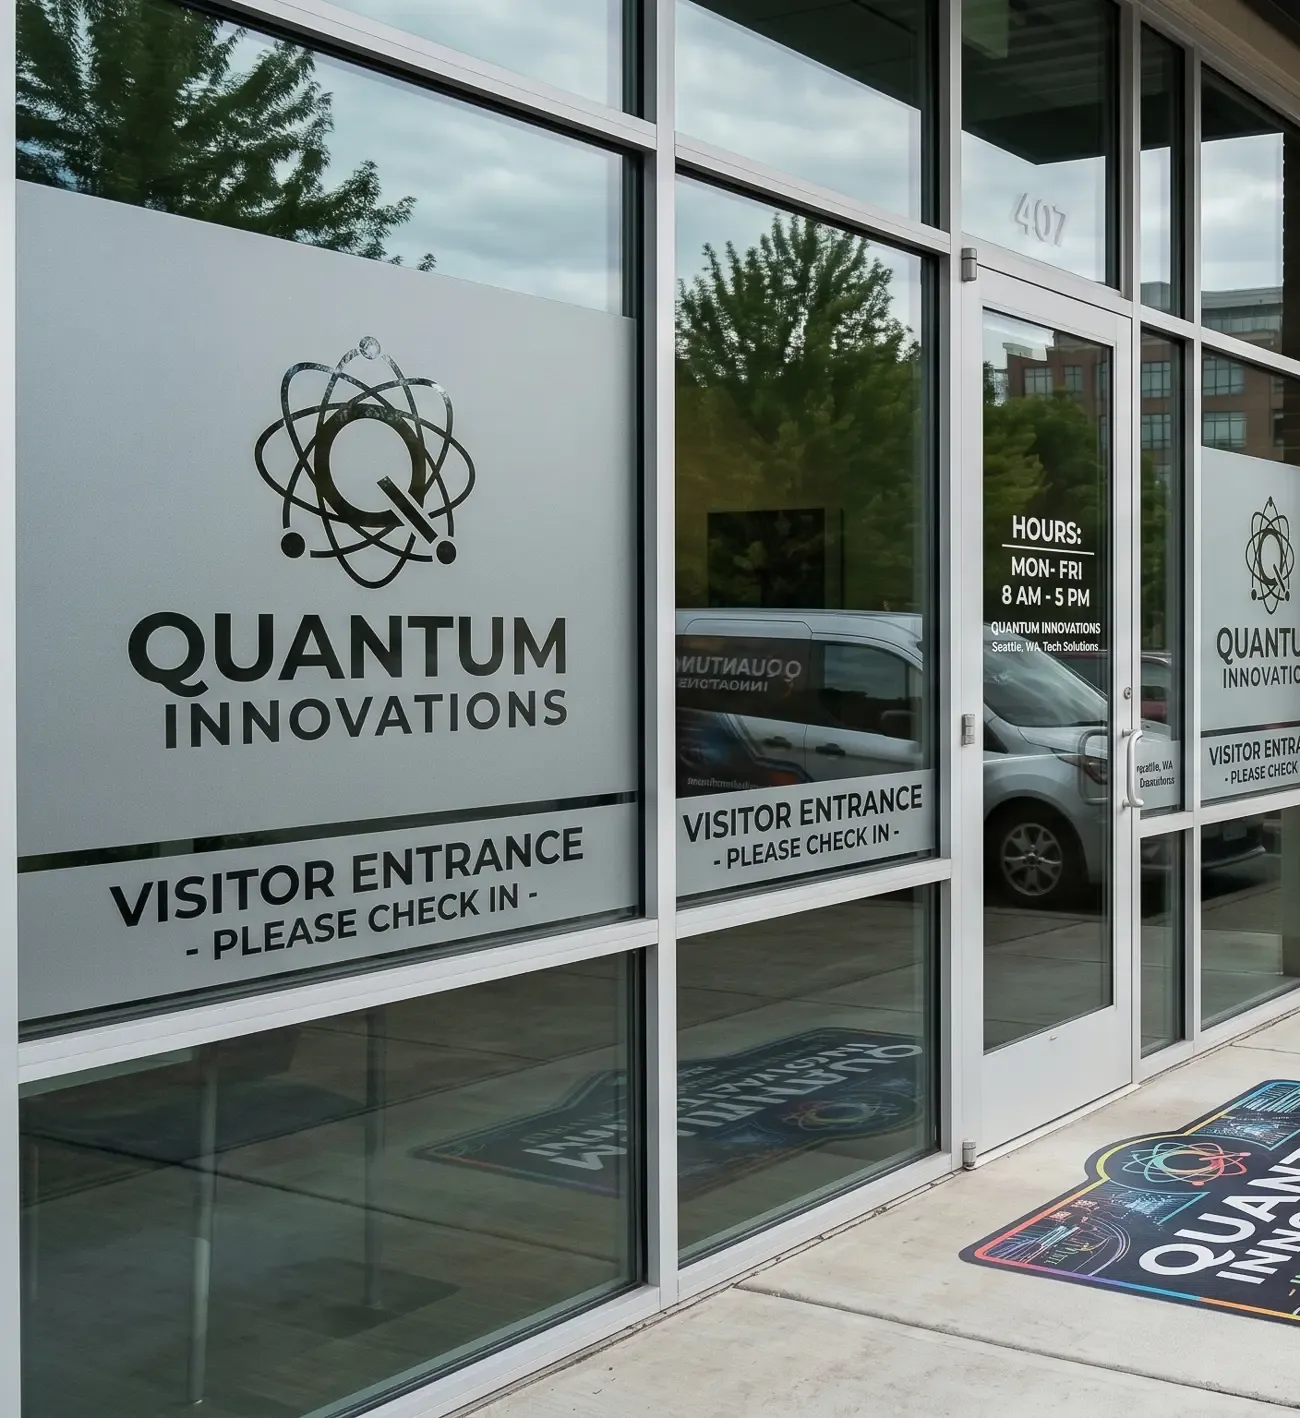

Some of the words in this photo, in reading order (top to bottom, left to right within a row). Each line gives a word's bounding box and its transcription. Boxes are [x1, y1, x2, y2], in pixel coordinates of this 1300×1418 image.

[1014, 192, 1066, 247] 407
[1012, 514, 1082, 545] HOURS:
[1060, 560, 1082, 580] FRI
[1002, 585, 1012, 605] 8
[1016, 586, 1041, 605] AM
[1055, 588, 1064, 607] 5
[1068, 588, 1090, 607] PM
[991, 621, 1040, 635] QUANTUM
[1041, 622, 1101, 634] INNOVATIONS
[1043, 641, 1062, 652] Tech
[1063, 641, 1098, 652] Solutions
[127, 610, 567, 698] QUANTUM
[165, 688, 568, 749] INNOVATIONS
[1209, 741, 1261, 766] VISITOR
[1230, 764, 1266, 784] PLEASE
[1267, 760, 1298, 778] CHECK
[682, 802, 792, 843] VISITOR
[800, 784, 923, 826] ENTRANCE
[727, 837, 801, 870] PLEASE
[806, 826, 867, 856] CHECK
[872, 823, 889, 845] IN
[109, 858, 335, 928] VISITOR
[351, 826, 584, 895] ENTRANCE
[212, 911, 357, 961] PLEASE
[367, 885, 478, 934] CHECK
[488, 882, 518, 912] IN
